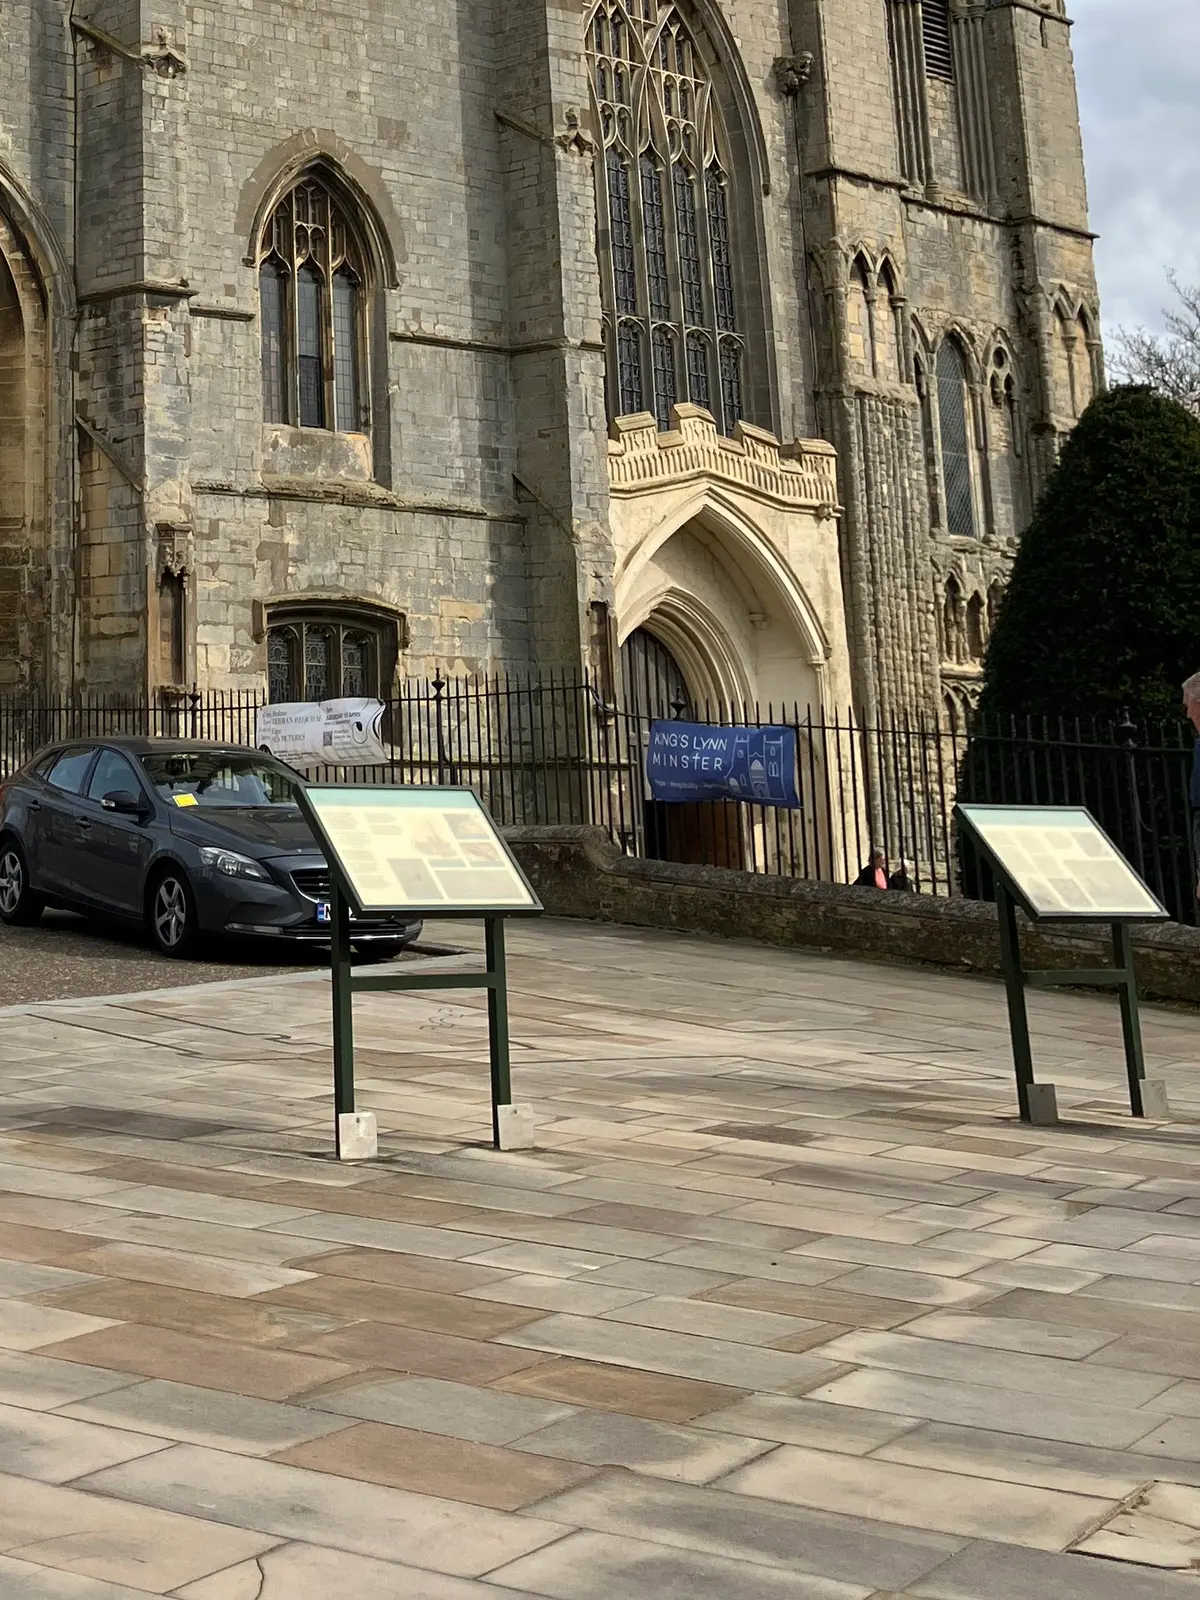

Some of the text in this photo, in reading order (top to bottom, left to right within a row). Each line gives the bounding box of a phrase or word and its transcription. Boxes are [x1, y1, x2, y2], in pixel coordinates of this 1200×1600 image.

[654, 732, 728, 751] KING'S LYNN
[652, 752, 723, 771] MINSTER
